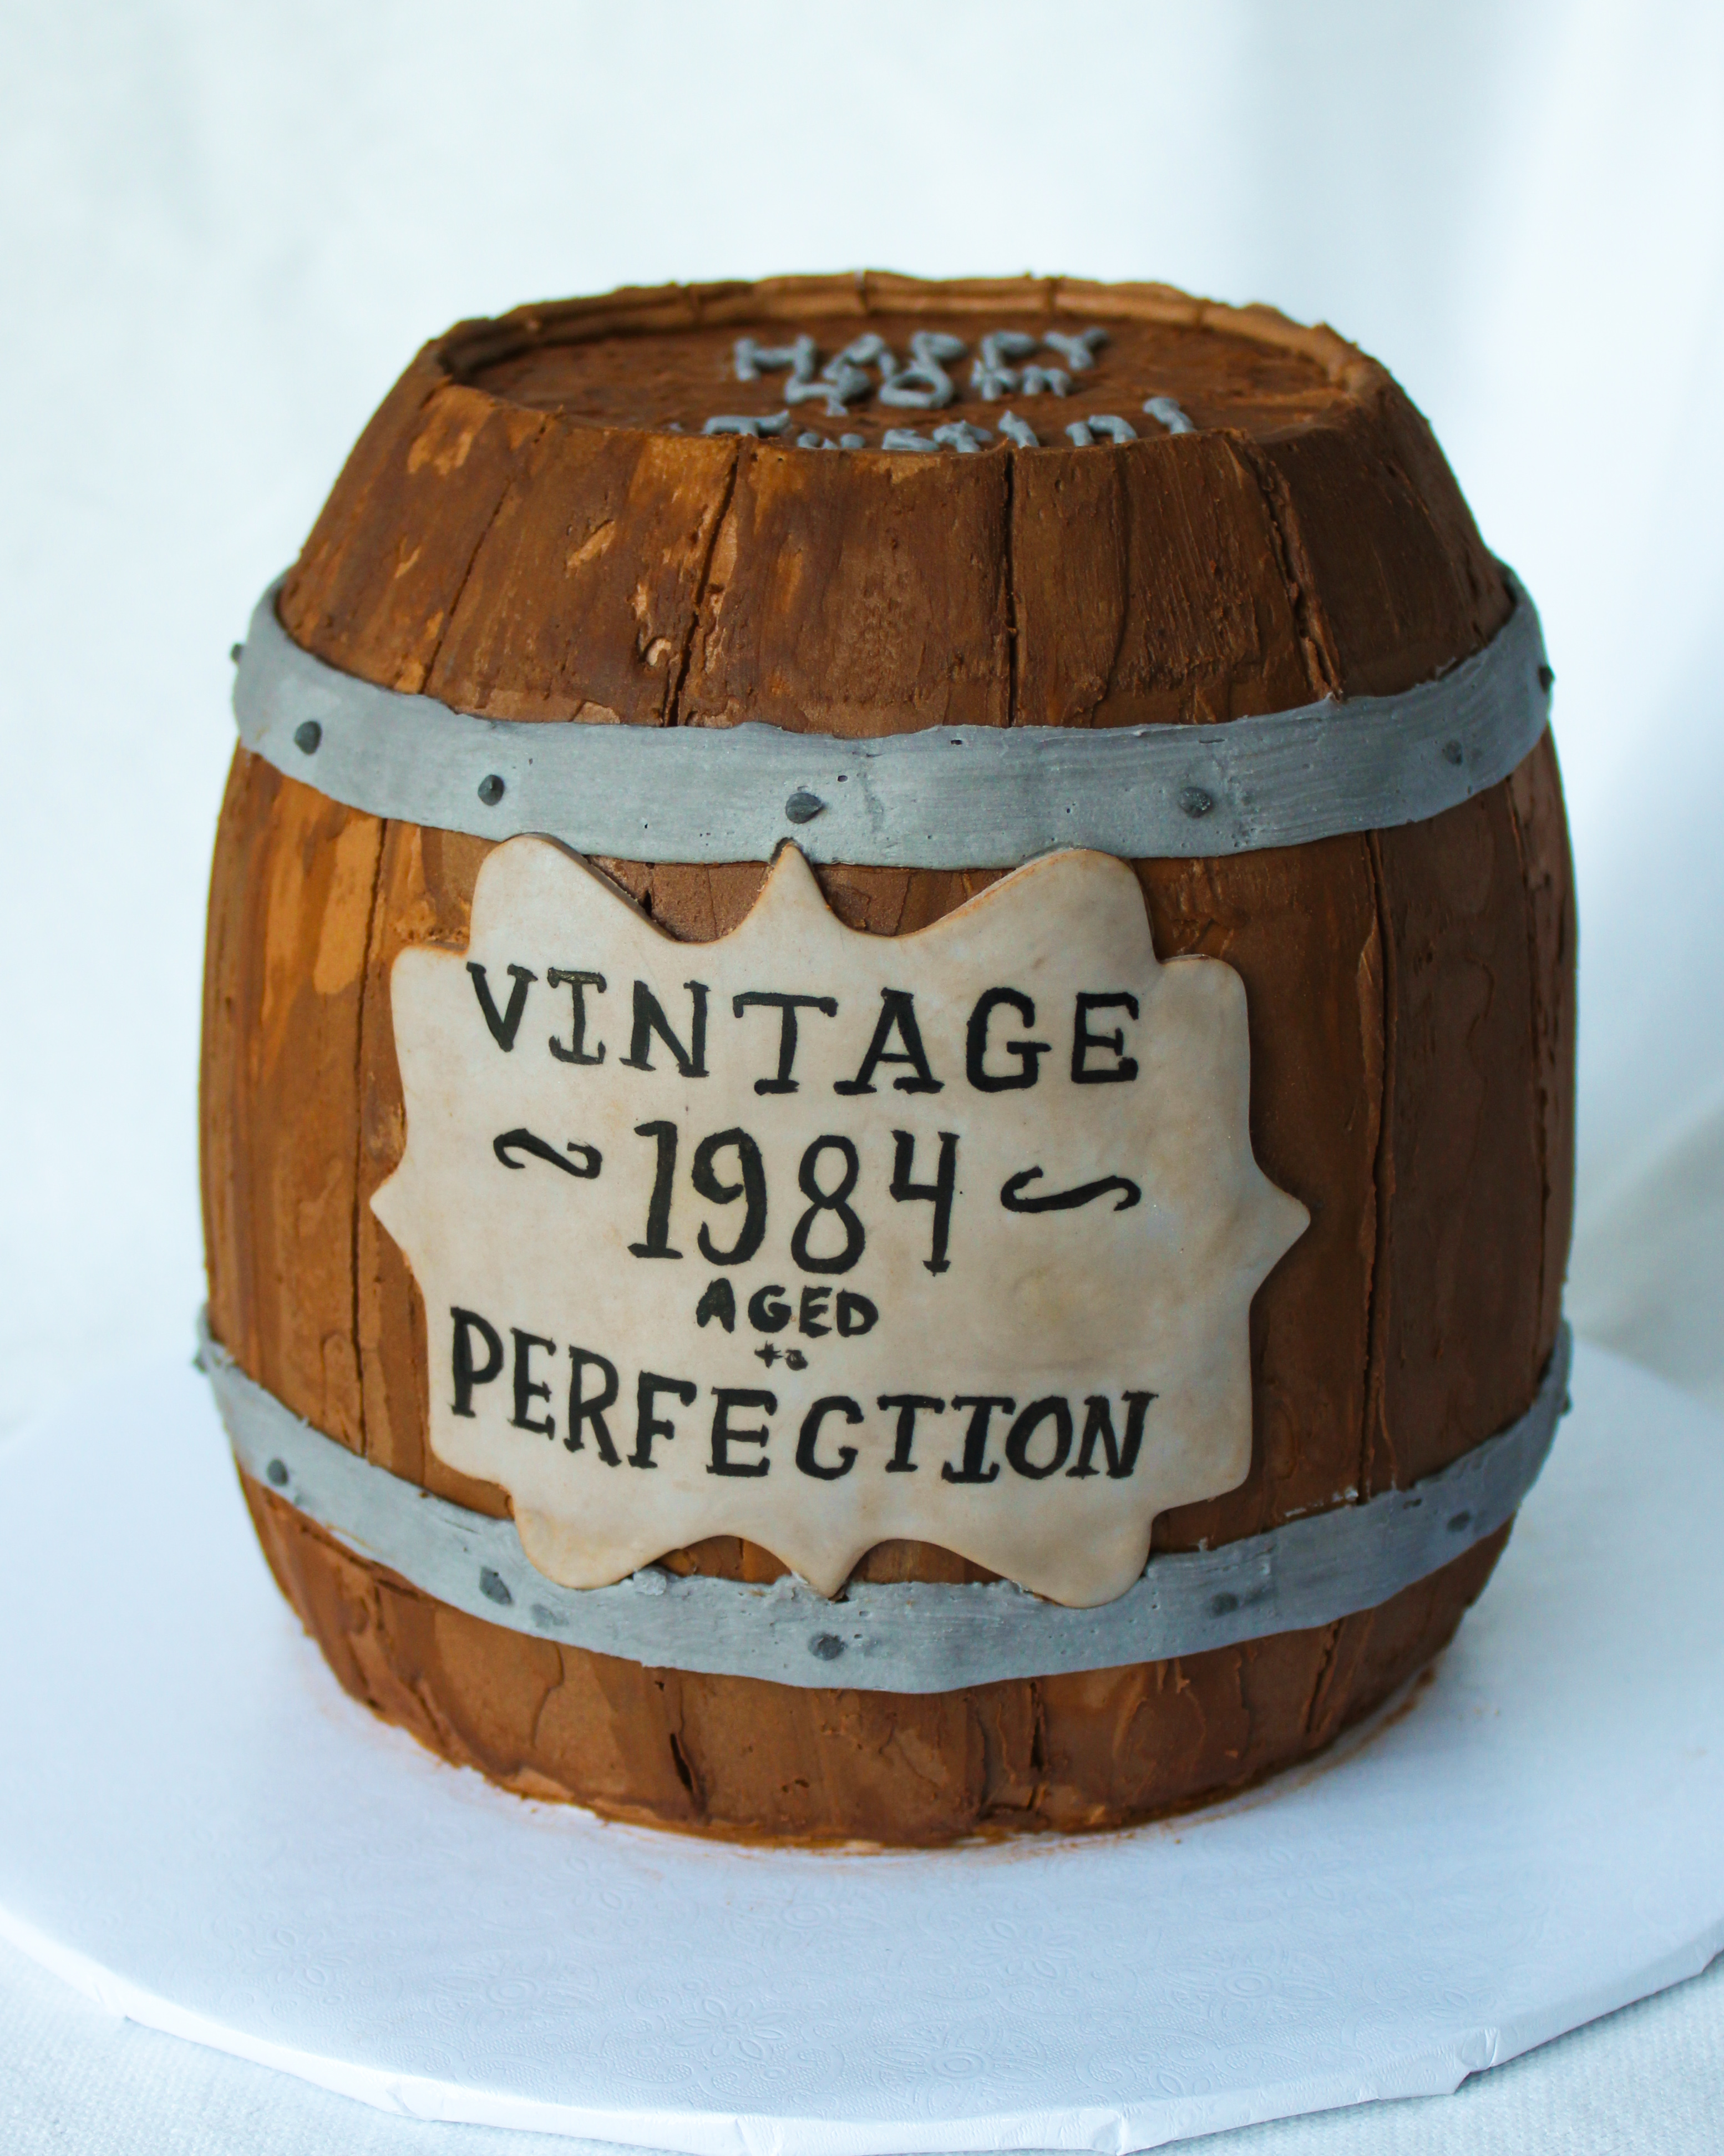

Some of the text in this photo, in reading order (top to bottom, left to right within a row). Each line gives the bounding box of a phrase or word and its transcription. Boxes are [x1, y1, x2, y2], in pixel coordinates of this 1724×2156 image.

[734, 326, 1109, 382] HAPPY
[466, 962, 1140, 1096] VINTAGE
[627, 1120, 960, 1277] 1984
[696, 1278, 879, 1338] AGED
[450, 1307, 1159, 1485] PERFECTION
